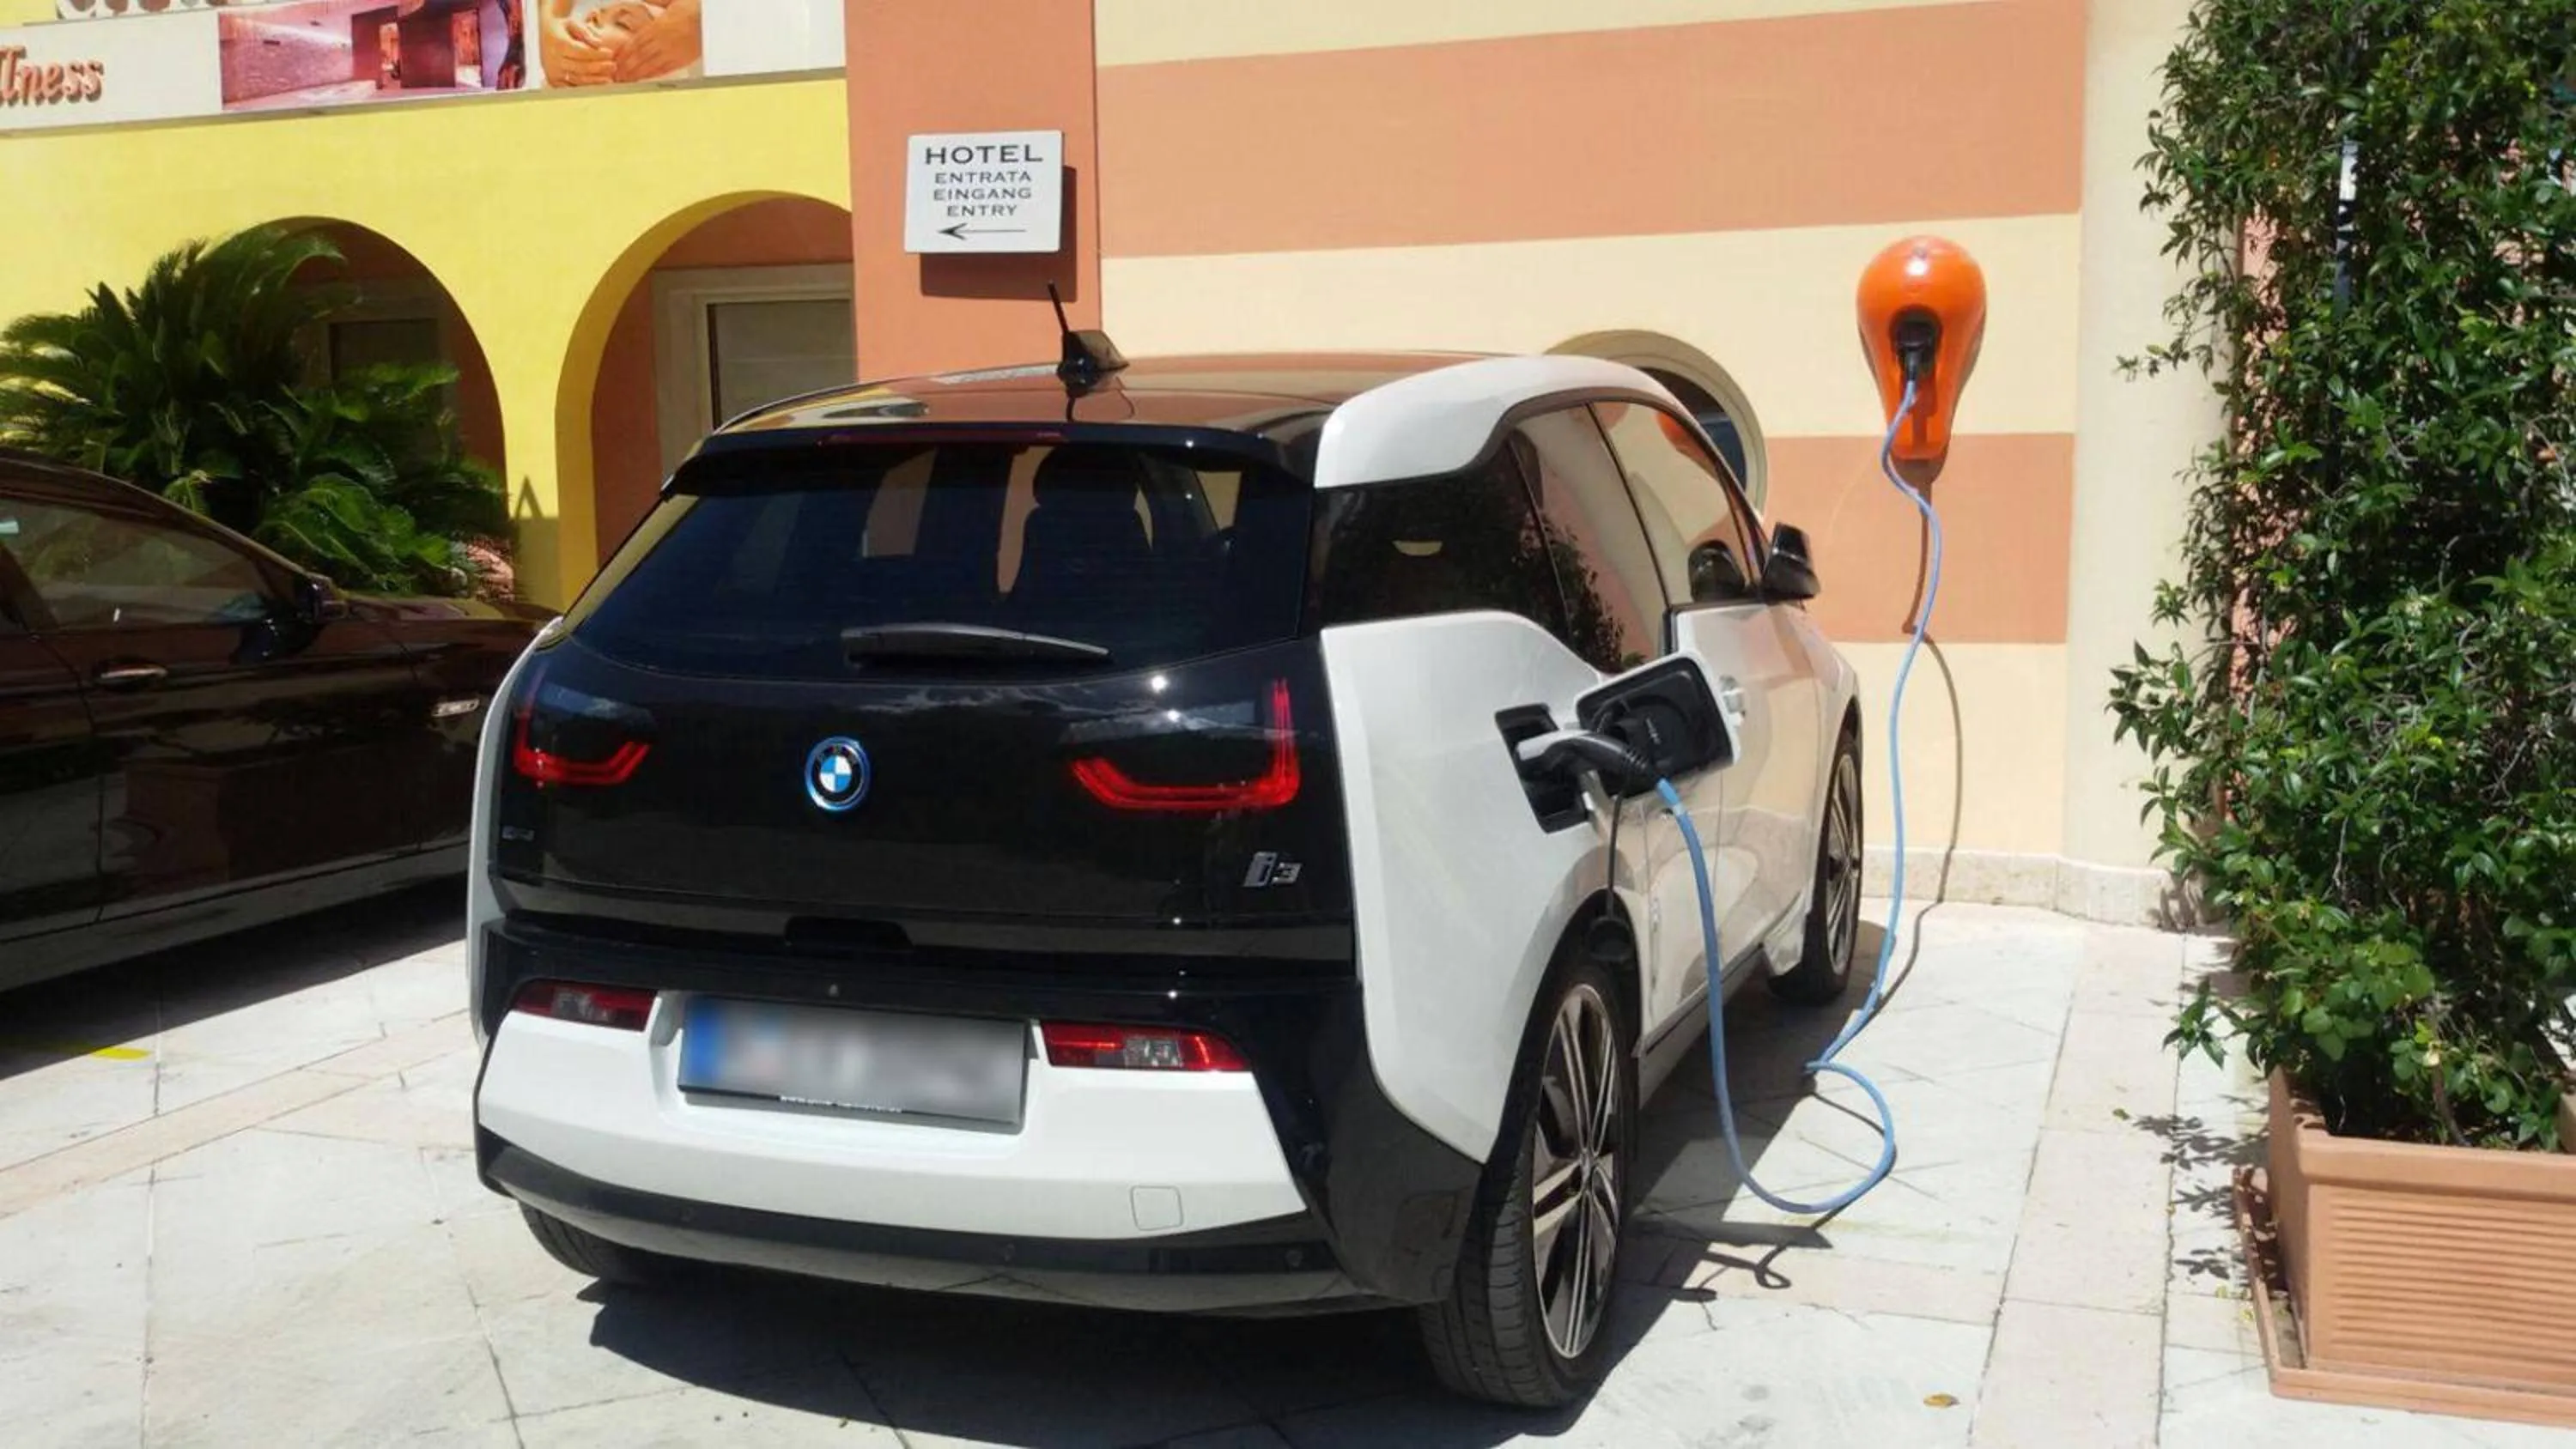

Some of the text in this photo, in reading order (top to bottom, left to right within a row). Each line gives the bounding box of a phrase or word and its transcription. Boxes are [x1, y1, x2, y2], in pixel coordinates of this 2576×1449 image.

[0, 45, 104, 106] lness
[925, 144, 1043, 165] HOTEL
[934, 171, 1032, 185] ENTRATA
[933, 187, 1032, 201] EINGANG
[947, 204, 1018, 217] ENTRY
